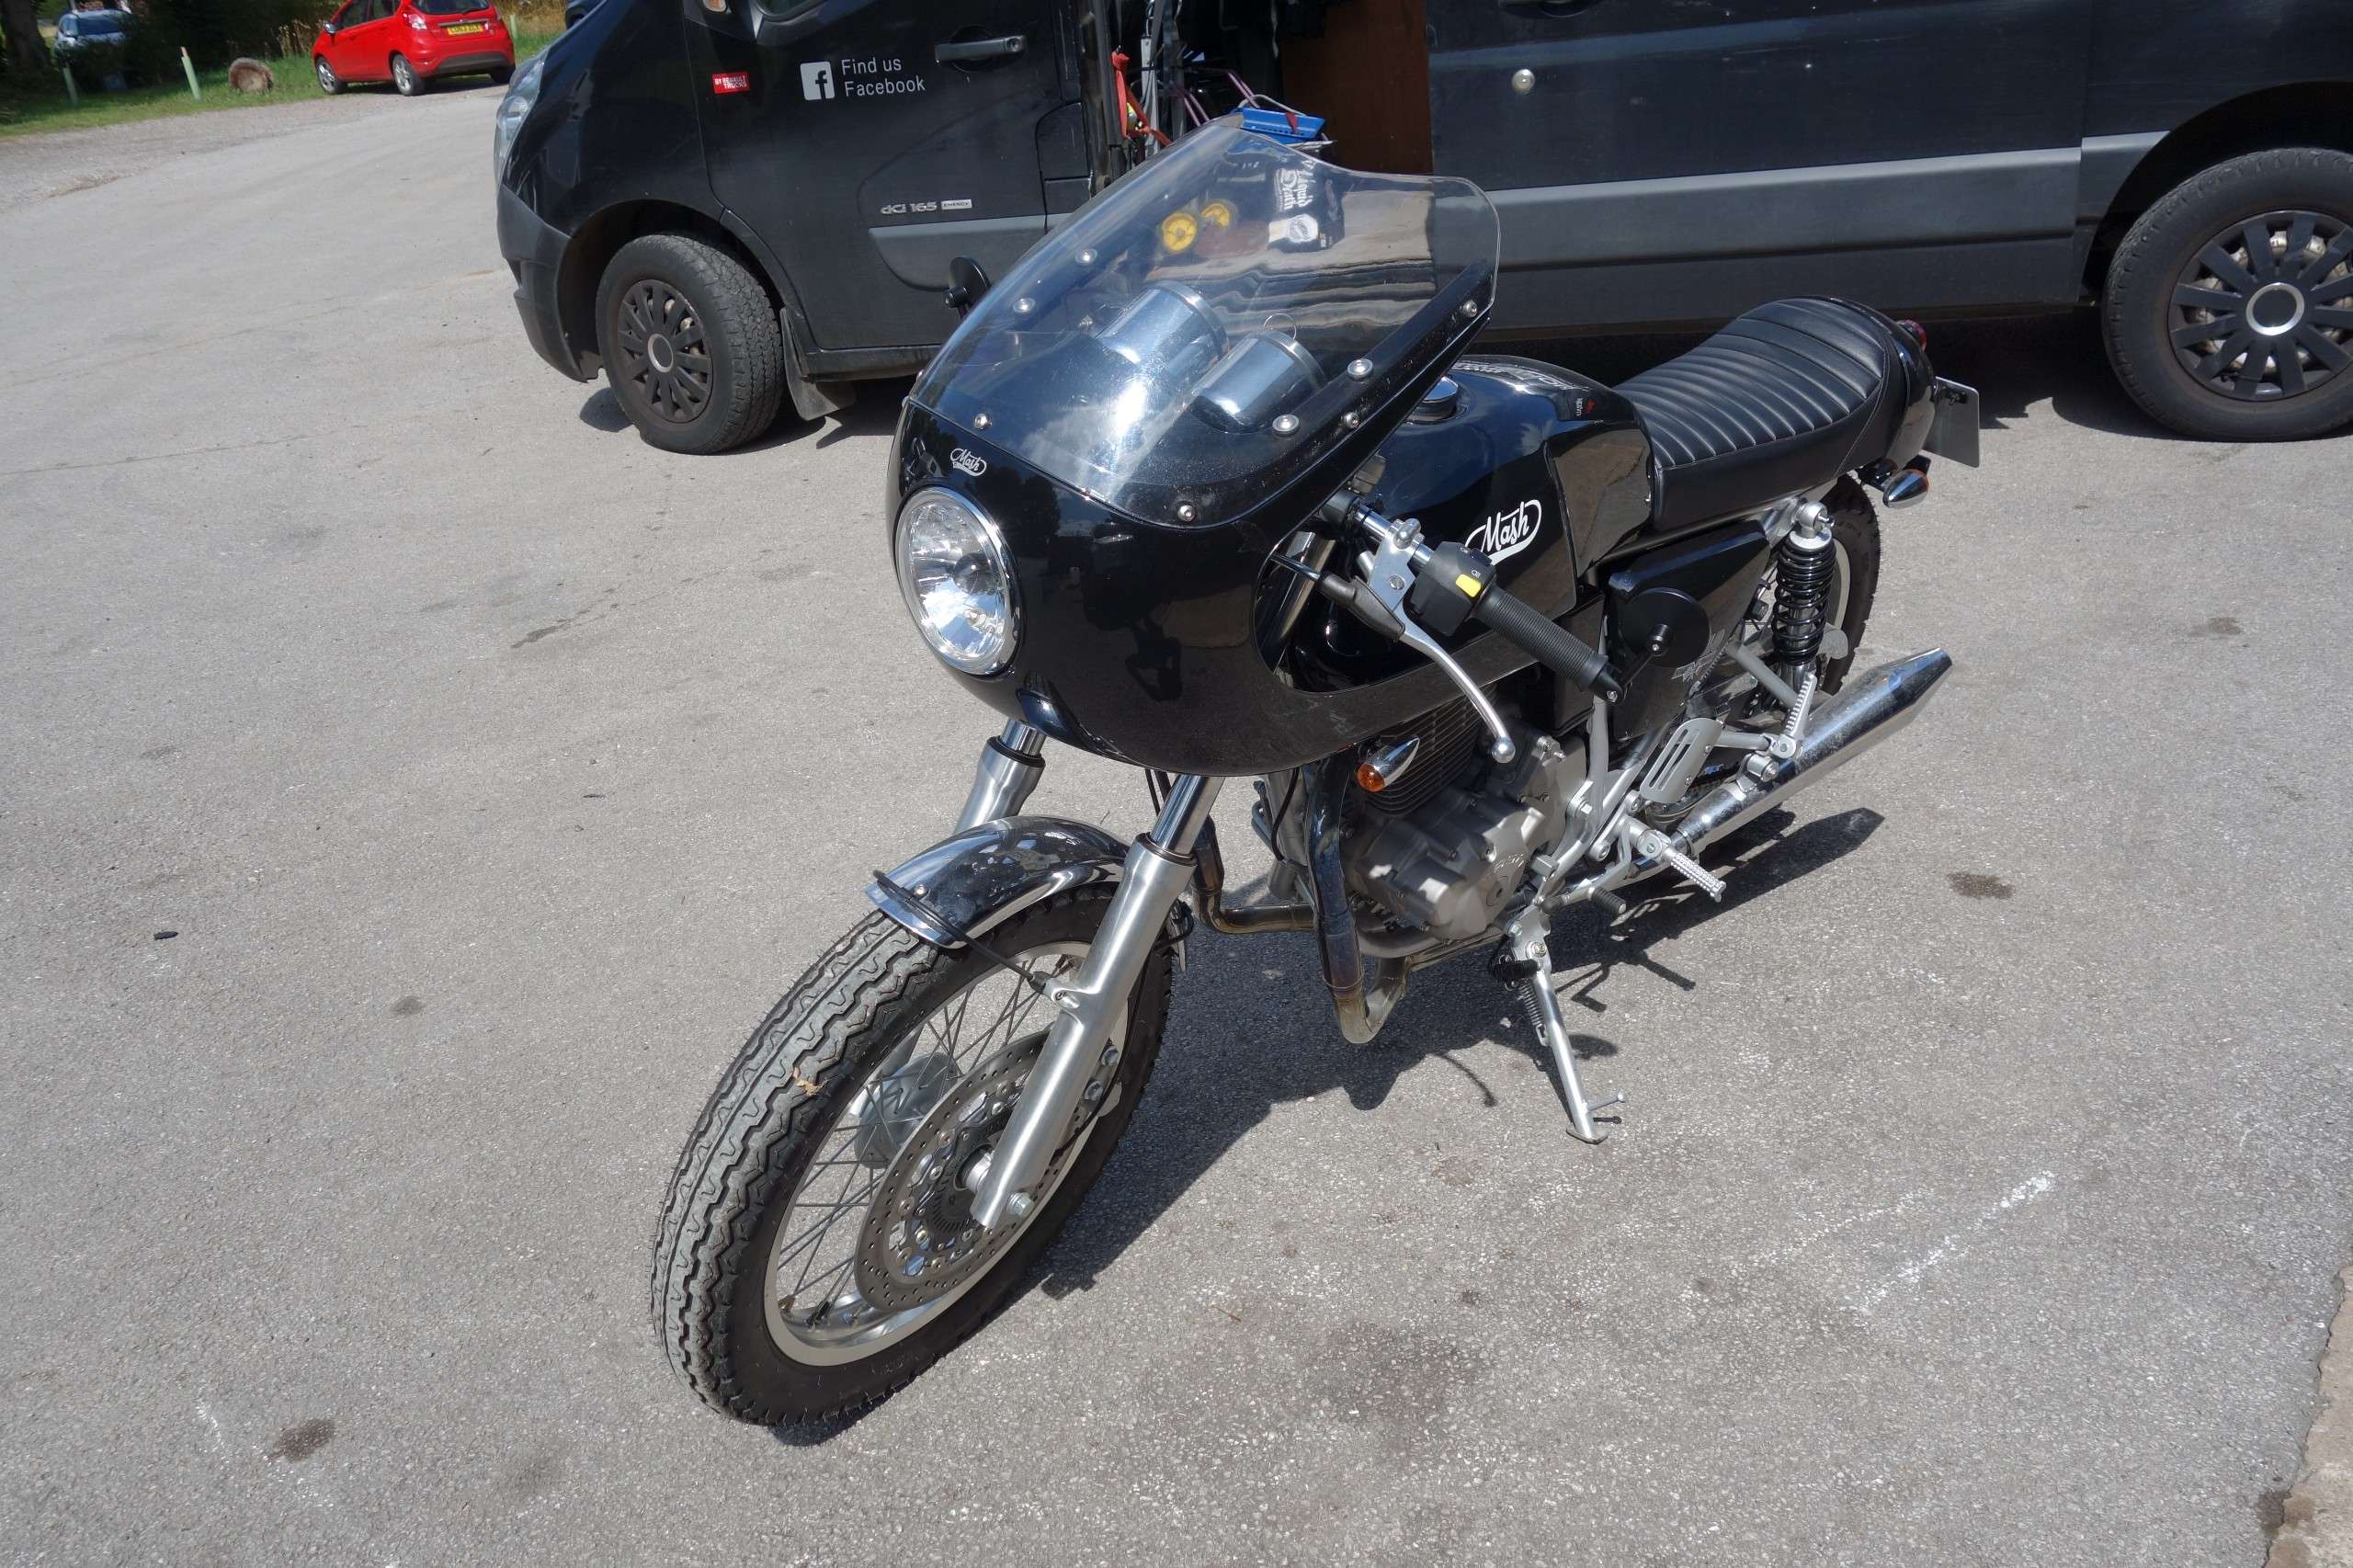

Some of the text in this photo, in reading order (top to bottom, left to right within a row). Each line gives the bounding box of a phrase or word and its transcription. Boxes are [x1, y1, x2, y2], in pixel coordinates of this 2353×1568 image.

[841, 57, 902, 75] Find us
[723, 81, 748, 90] TRUCKS
[844, 75, 926, 97] Facebook
[910, 201, 938, 213] 165
[950, 449, 986, 472] Mash
[1465, 499, 1541, 553] Mash
